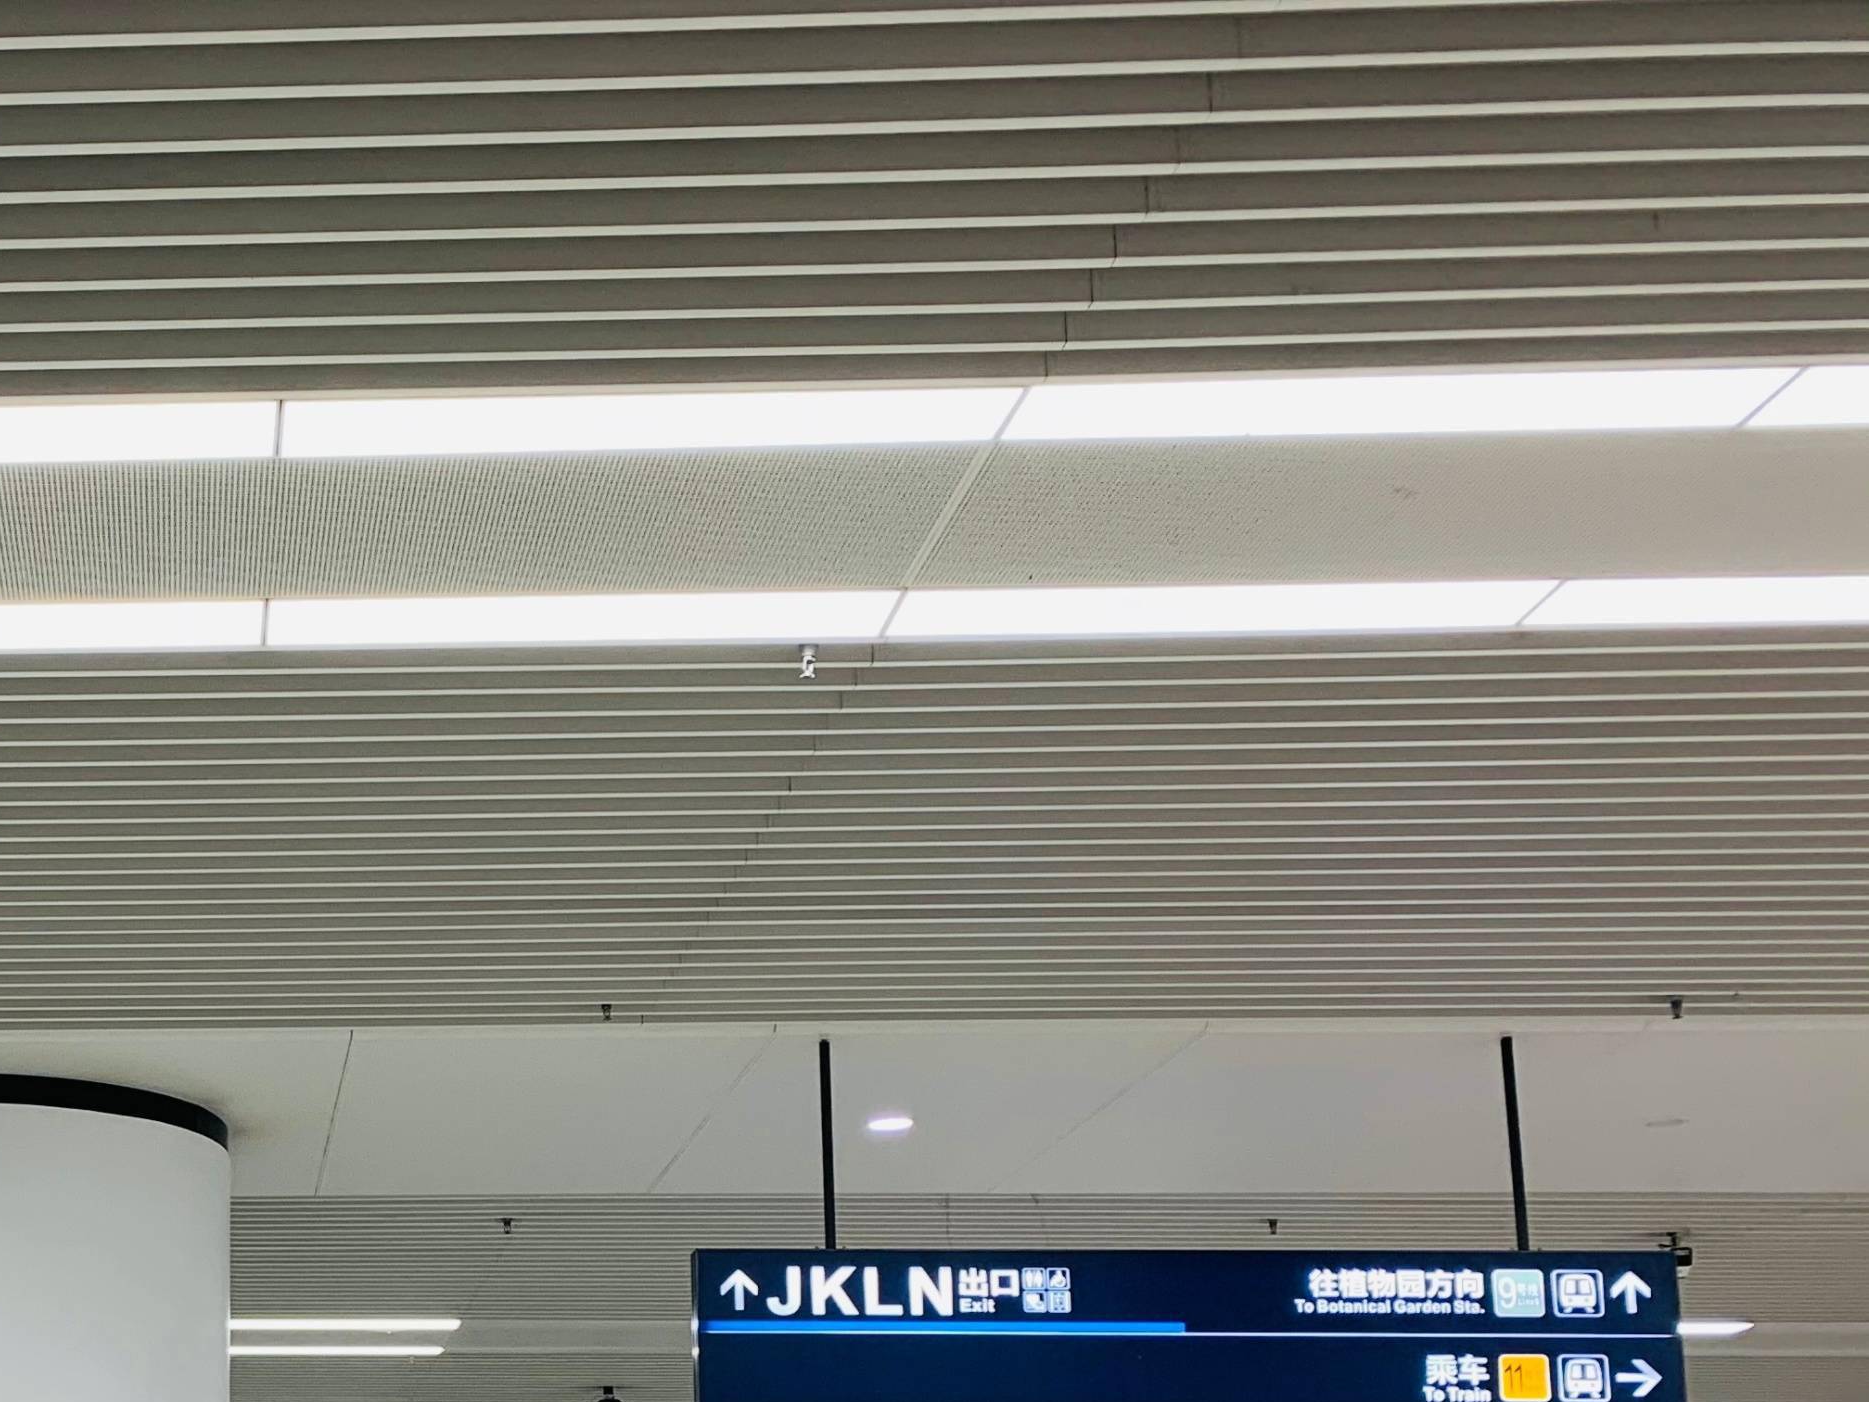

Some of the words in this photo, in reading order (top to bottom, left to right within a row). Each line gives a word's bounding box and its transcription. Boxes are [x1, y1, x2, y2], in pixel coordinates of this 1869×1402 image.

[766, 1265, 954, 1316] JKLN
[958, 1267, 1020, 1297] 出口
[1308, 1268, 1485, 1299] 往植物园方向
[959, 1298, 996, 1313] Exit
[1295, 1299, 1314, 1314] To
[1316, 1299, 1391, 1314] Botanical
[1393, 1300, 1452, 1314] Garden
[1454, 1300, 1486, 1314] Sta.
[1426, 1354, 1490, 1385] 乘车
[1505, 1364, 1523, 1393] 11
[1422, 1386, 1445, 1402] To
[1446, 1386, 1492, 1402] Train
